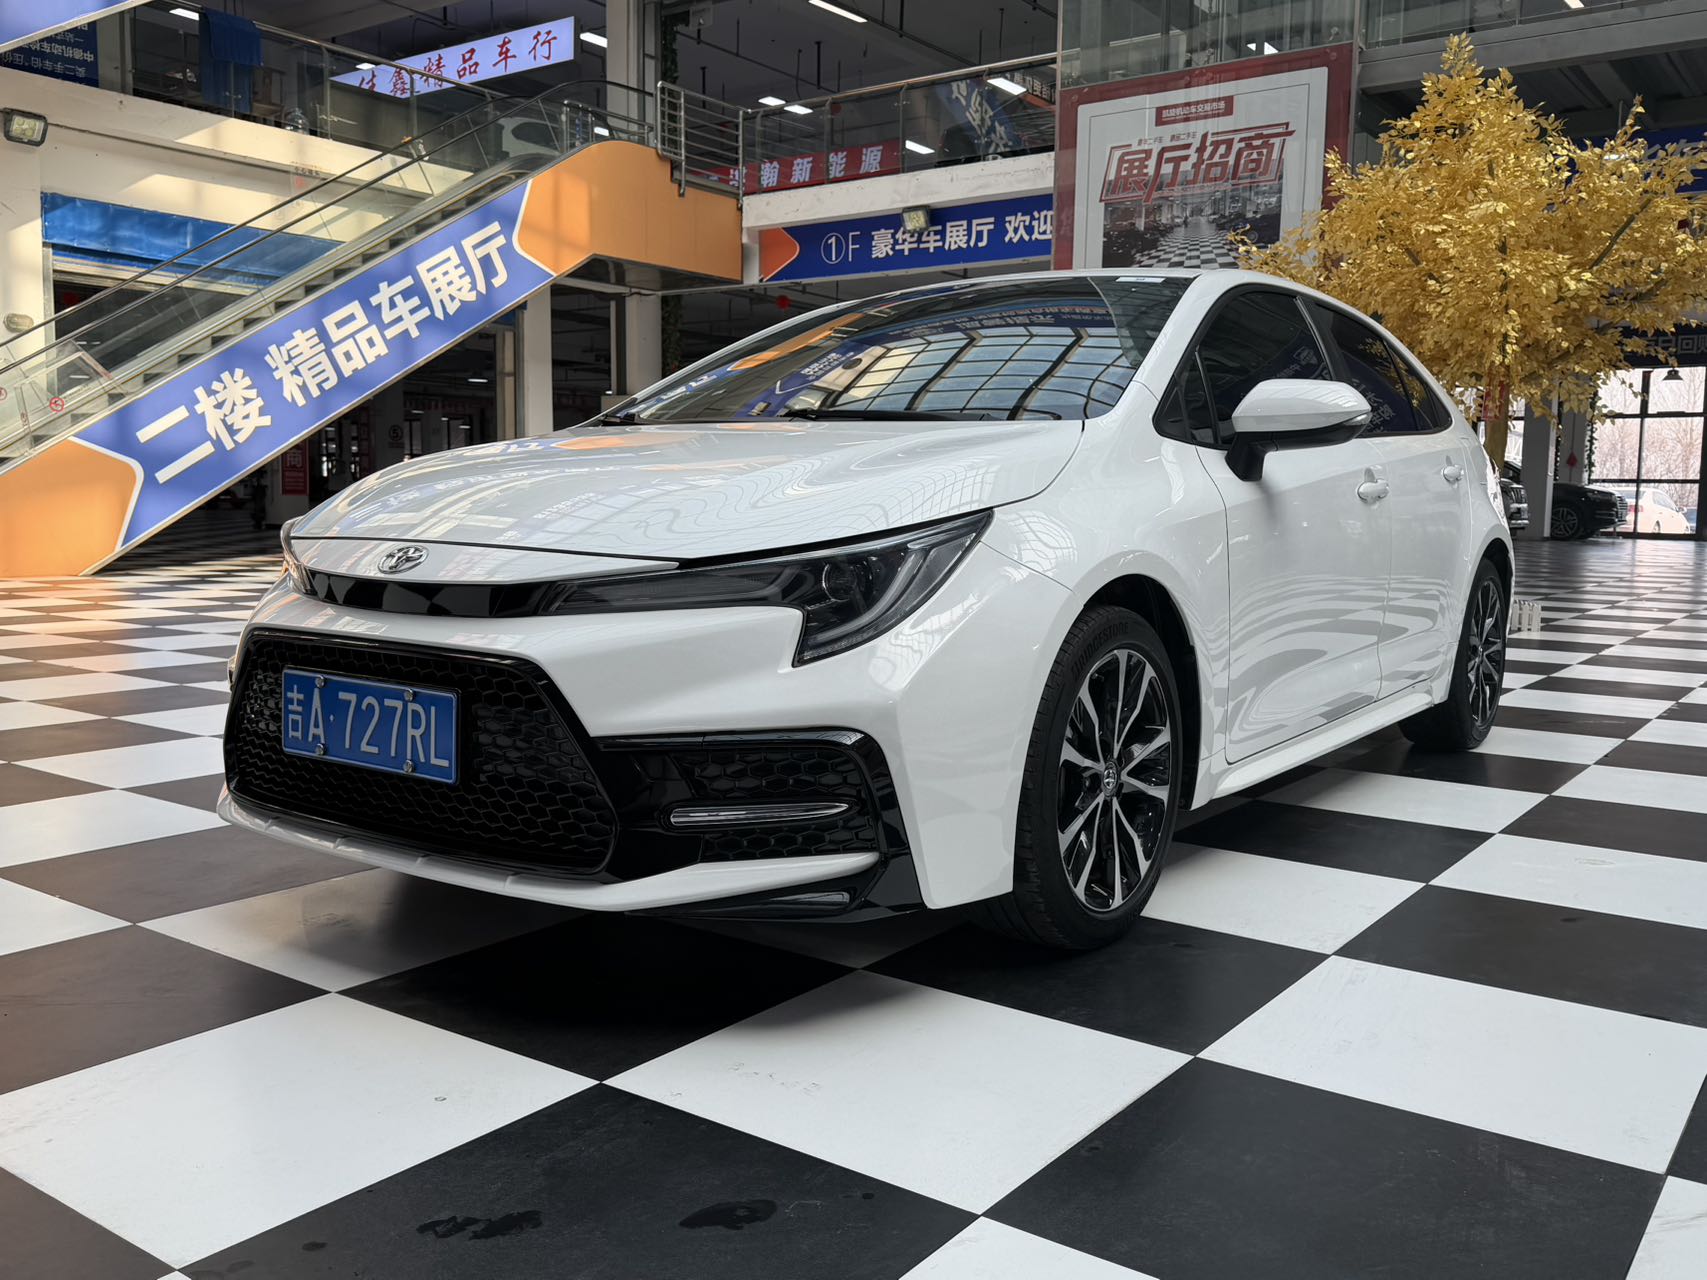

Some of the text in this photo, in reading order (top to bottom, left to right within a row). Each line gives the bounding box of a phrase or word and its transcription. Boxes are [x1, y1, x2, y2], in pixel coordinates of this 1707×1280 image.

[20, 40, 94, 62] 中德机动车检
[1111, 130, 1296, 204] 展厅招商
[871, 217, 994, 260] 豪华车展厅
[136, 220, 509, 484] 二楼 精品车展厅
